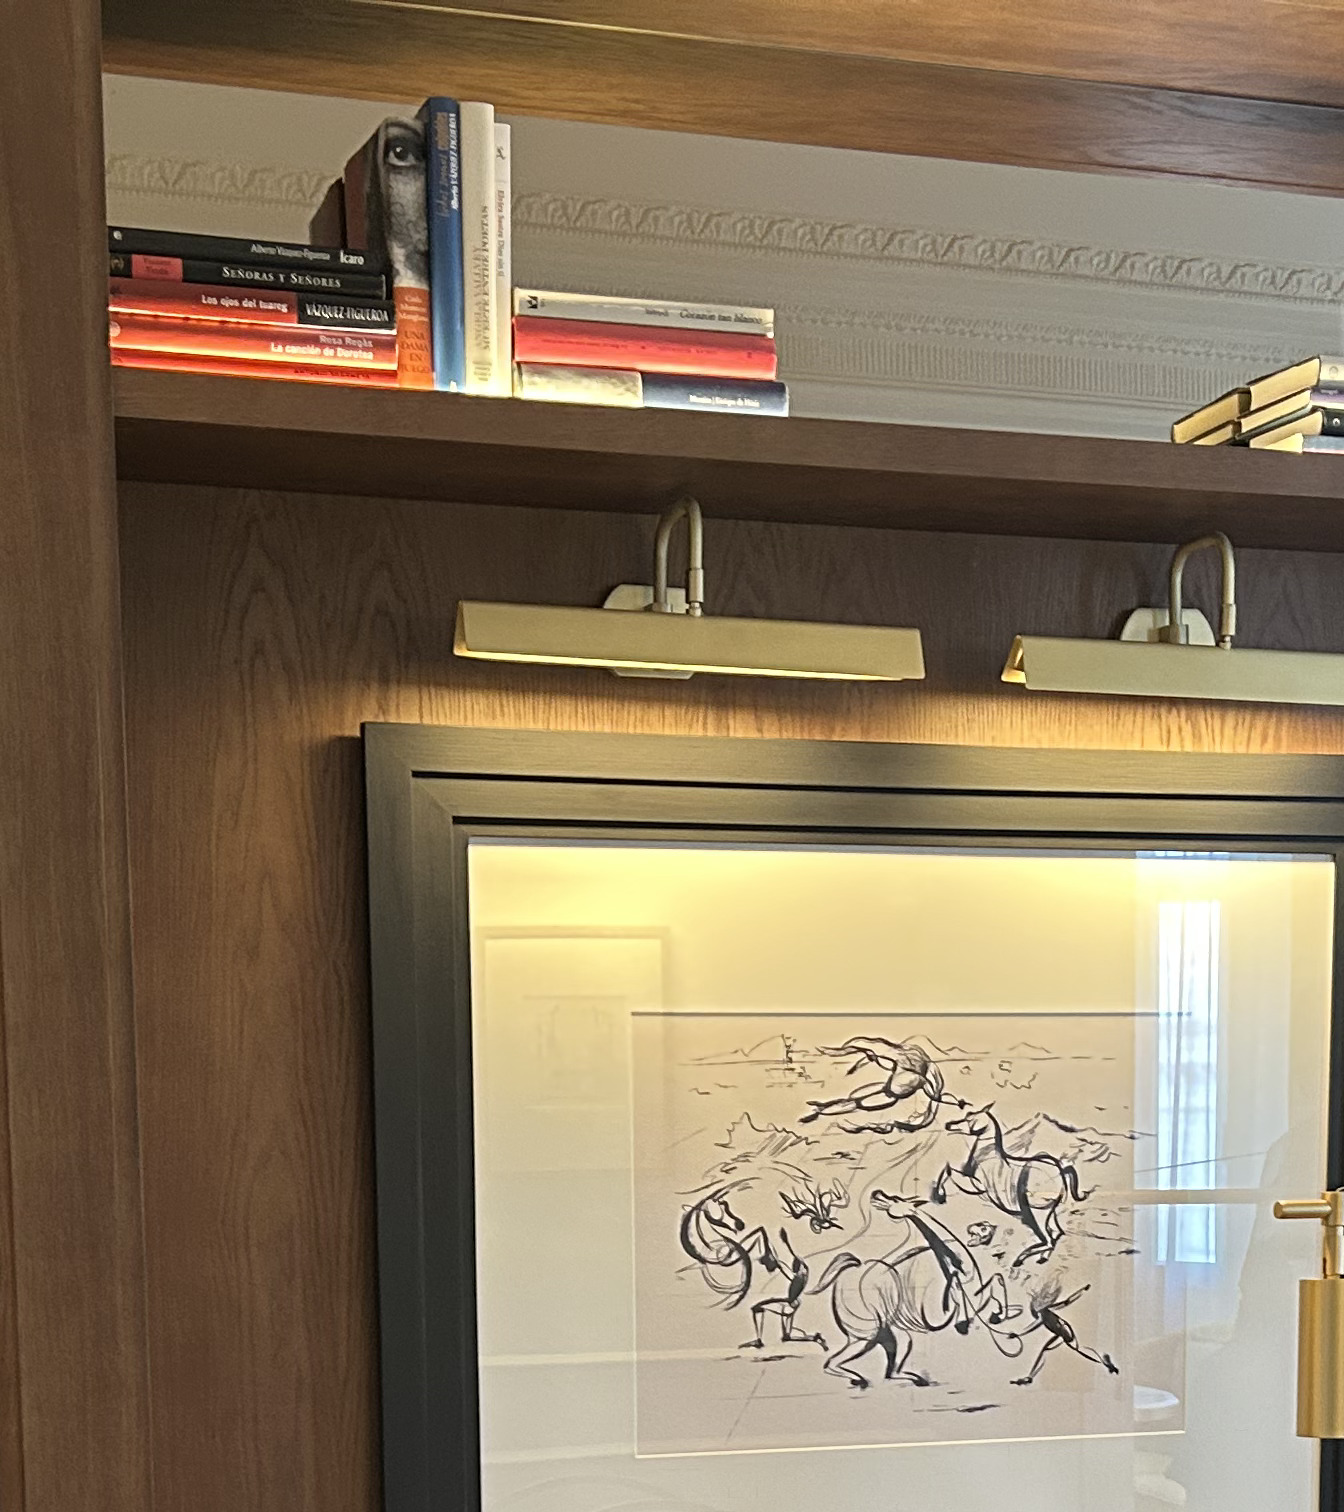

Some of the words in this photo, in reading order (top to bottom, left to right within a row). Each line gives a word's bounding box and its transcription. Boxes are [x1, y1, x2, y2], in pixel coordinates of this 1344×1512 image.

[201, 294, 218, 306] Los
[220, 296, 241, 309] ojos
[242, 297, 257, 309] del
[259, 300, 289, 313] tuareg
[319, 335, 343, 346] Rosa
[270, 341, 283, 353] La
[285, 342, 322, 355] canción
[322, 345, 335, 357] de
[336, 347, 374, 360] Dorotea
